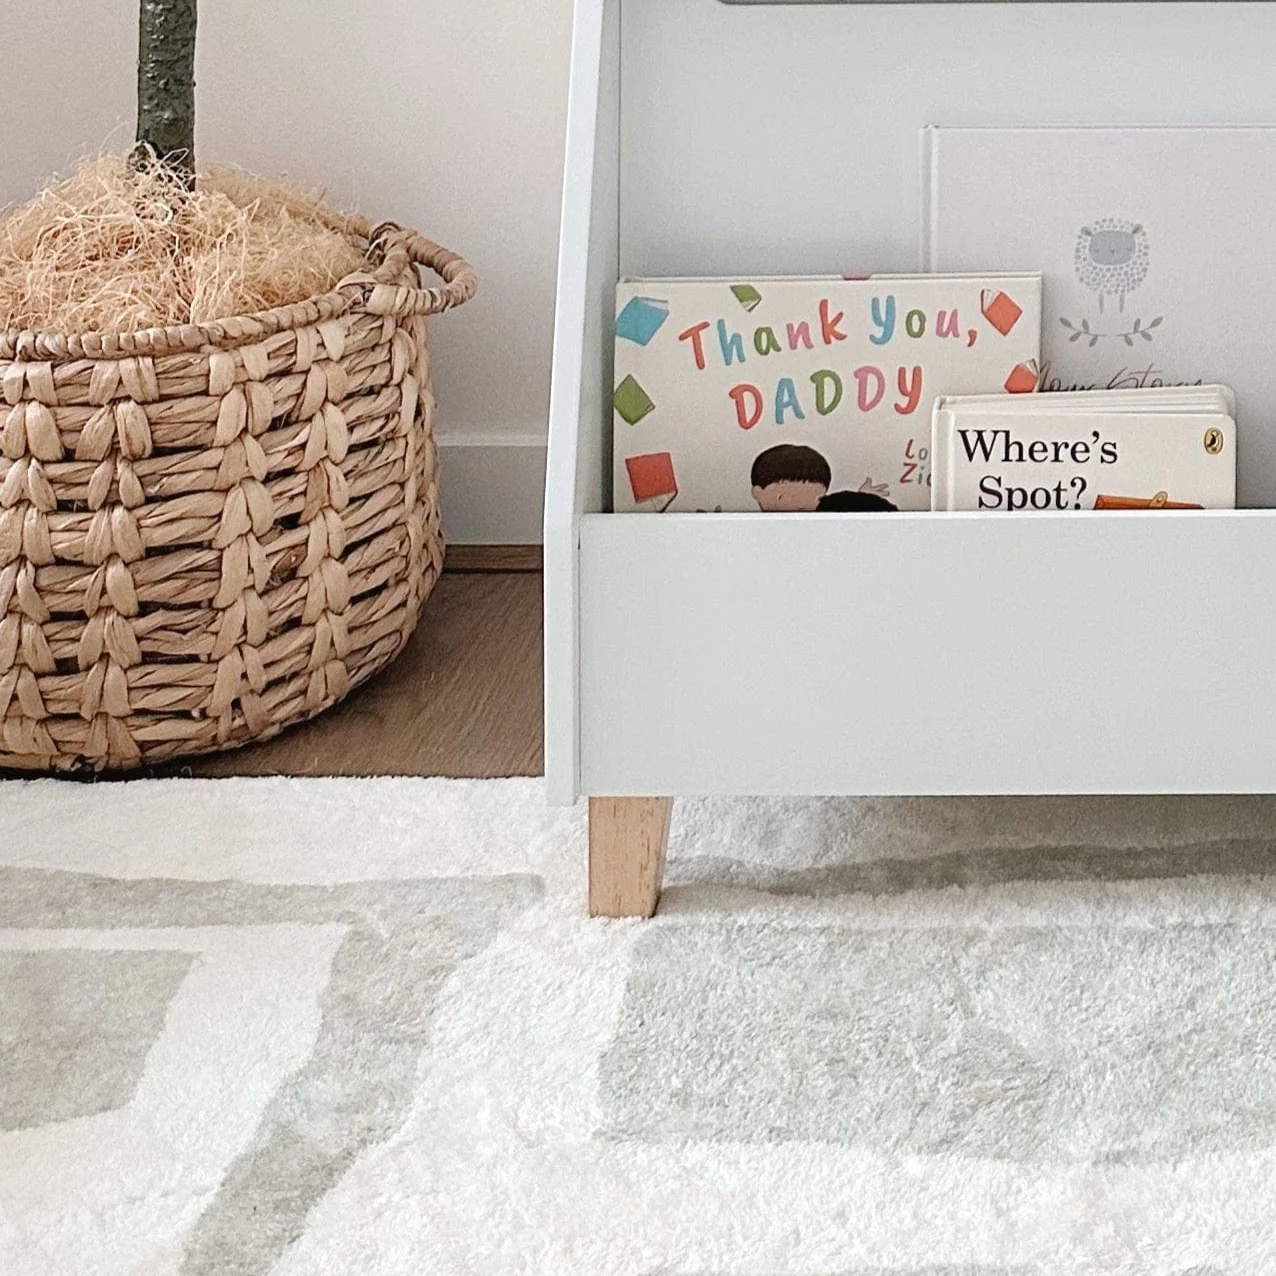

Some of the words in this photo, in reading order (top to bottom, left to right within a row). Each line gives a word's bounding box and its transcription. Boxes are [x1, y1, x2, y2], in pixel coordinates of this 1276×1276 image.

[679, 299, 847, 370] Thank
[729, 365, 923, 430] DADDY
[957, 429, 1119, 464] Where's
[978, 476, 1088, 511] Spot?
